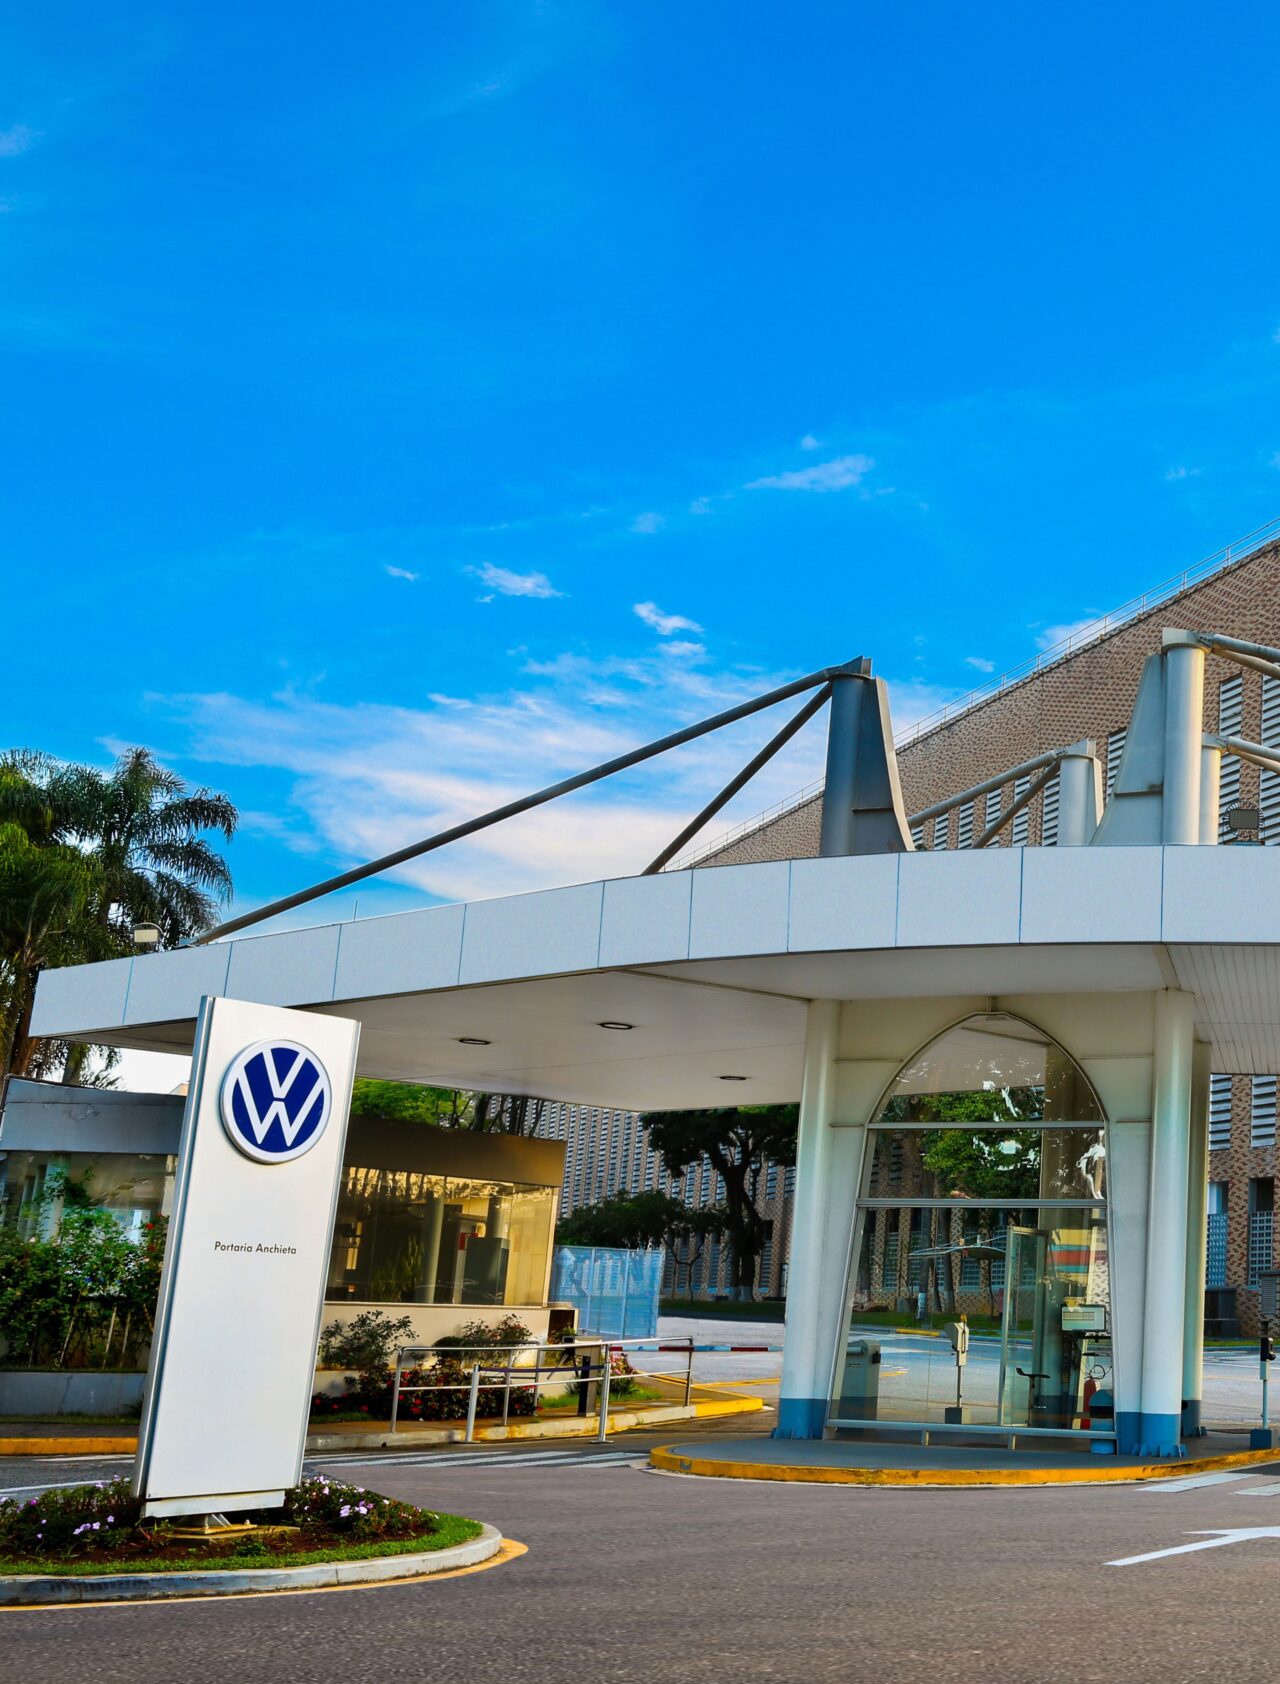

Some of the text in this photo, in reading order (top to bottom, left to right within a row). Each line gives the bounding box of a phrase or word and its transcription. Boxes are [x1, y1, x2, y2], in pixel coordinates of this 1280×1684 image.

[232, 1046, 324, 1152] VW
[214, 1241, 297, 1254] Portaria Anchieta
